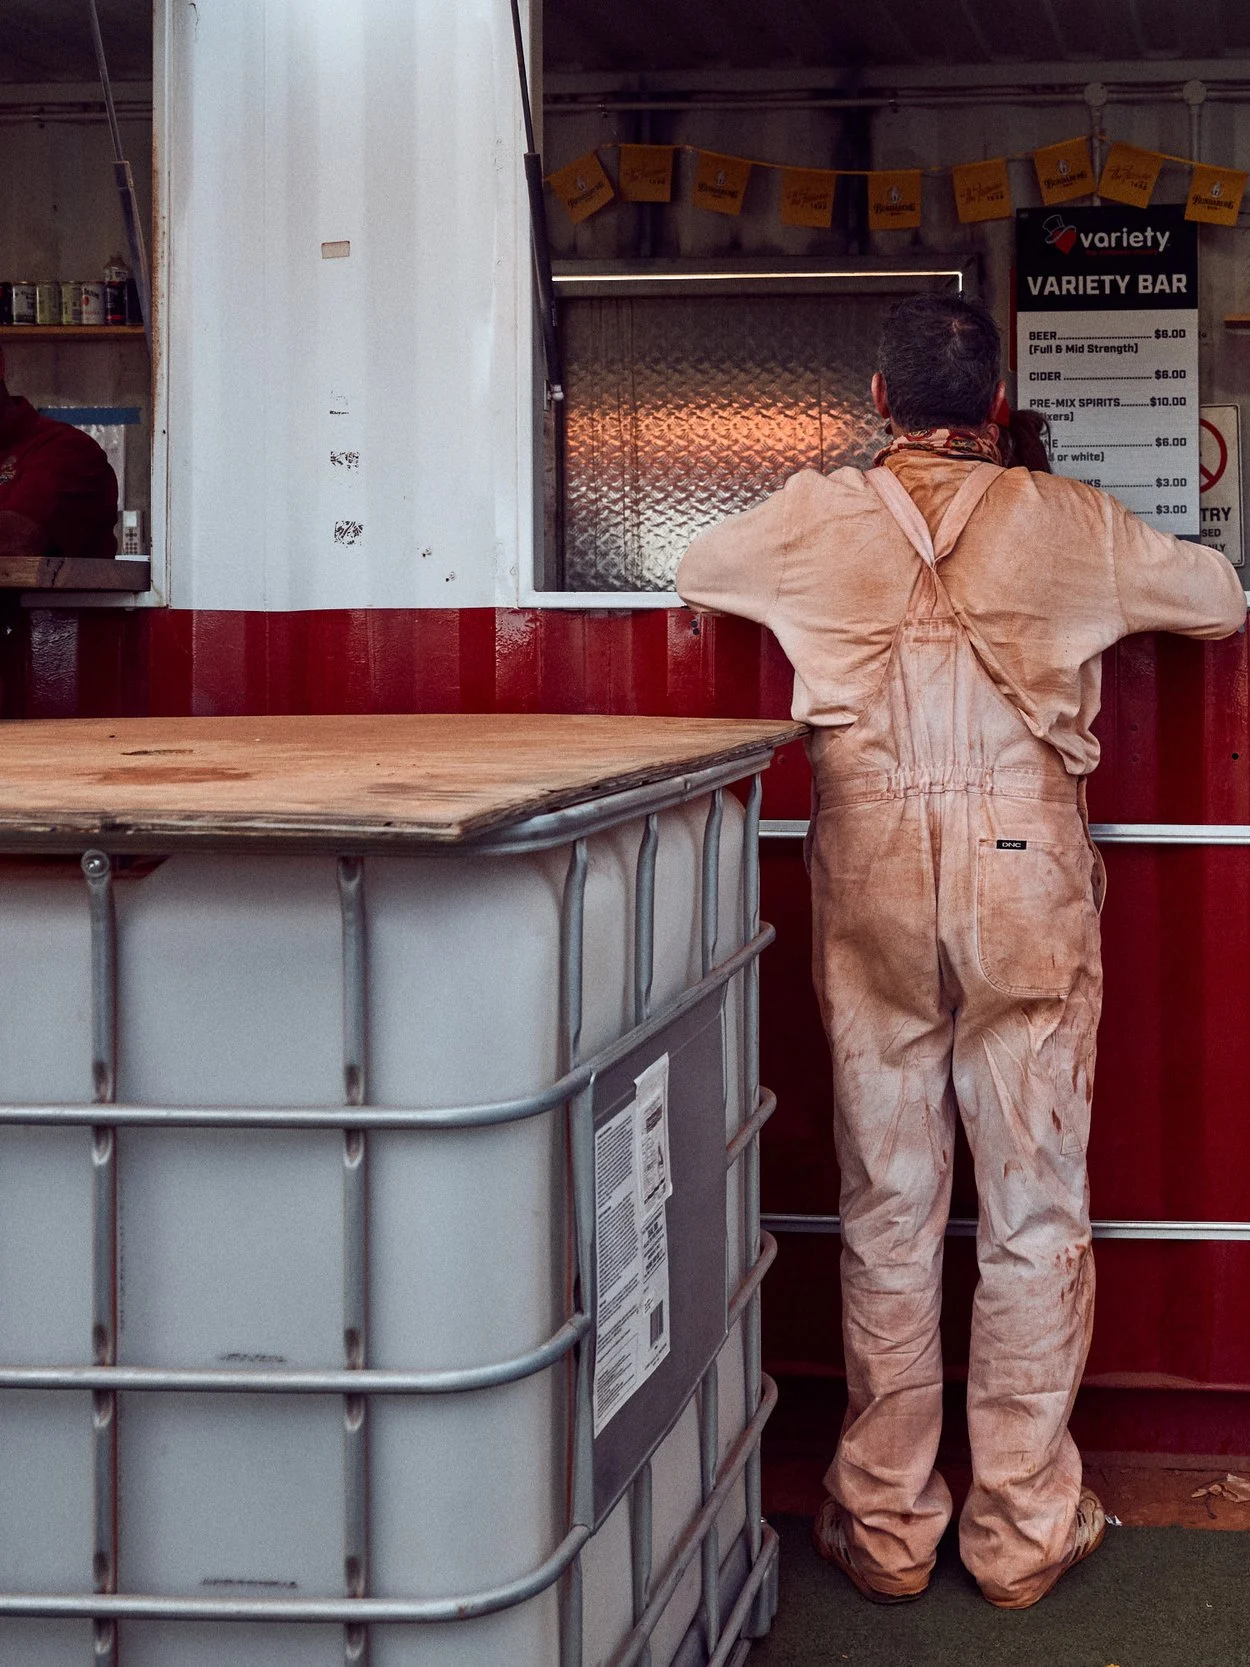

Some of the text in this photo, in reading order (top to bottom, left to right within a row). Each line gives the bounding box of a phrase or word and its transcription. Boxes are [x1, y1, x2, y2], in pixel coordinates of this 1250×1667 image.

[1080, 226, 1170, 252] variety
[1027, 273, 1188, 296] VARIETY BAR
[1029, 328, 1186, 341] BEER $6.00
[1055, 345, 1063, 354] &
[1065, 344, 1085, 354] Mid
[1029, 369, 1186, 381] CIDER $6.00
[1029, 396, 1187, 408] PRE-MIX SPIRITS $10.00
[1155, 437, 1187, 448] $6.00
[1155, 477, 1187, 488] $3.00
[1156, 504, 1188, 515] $3.00
[1200, 507, 1232, 522] TRY
